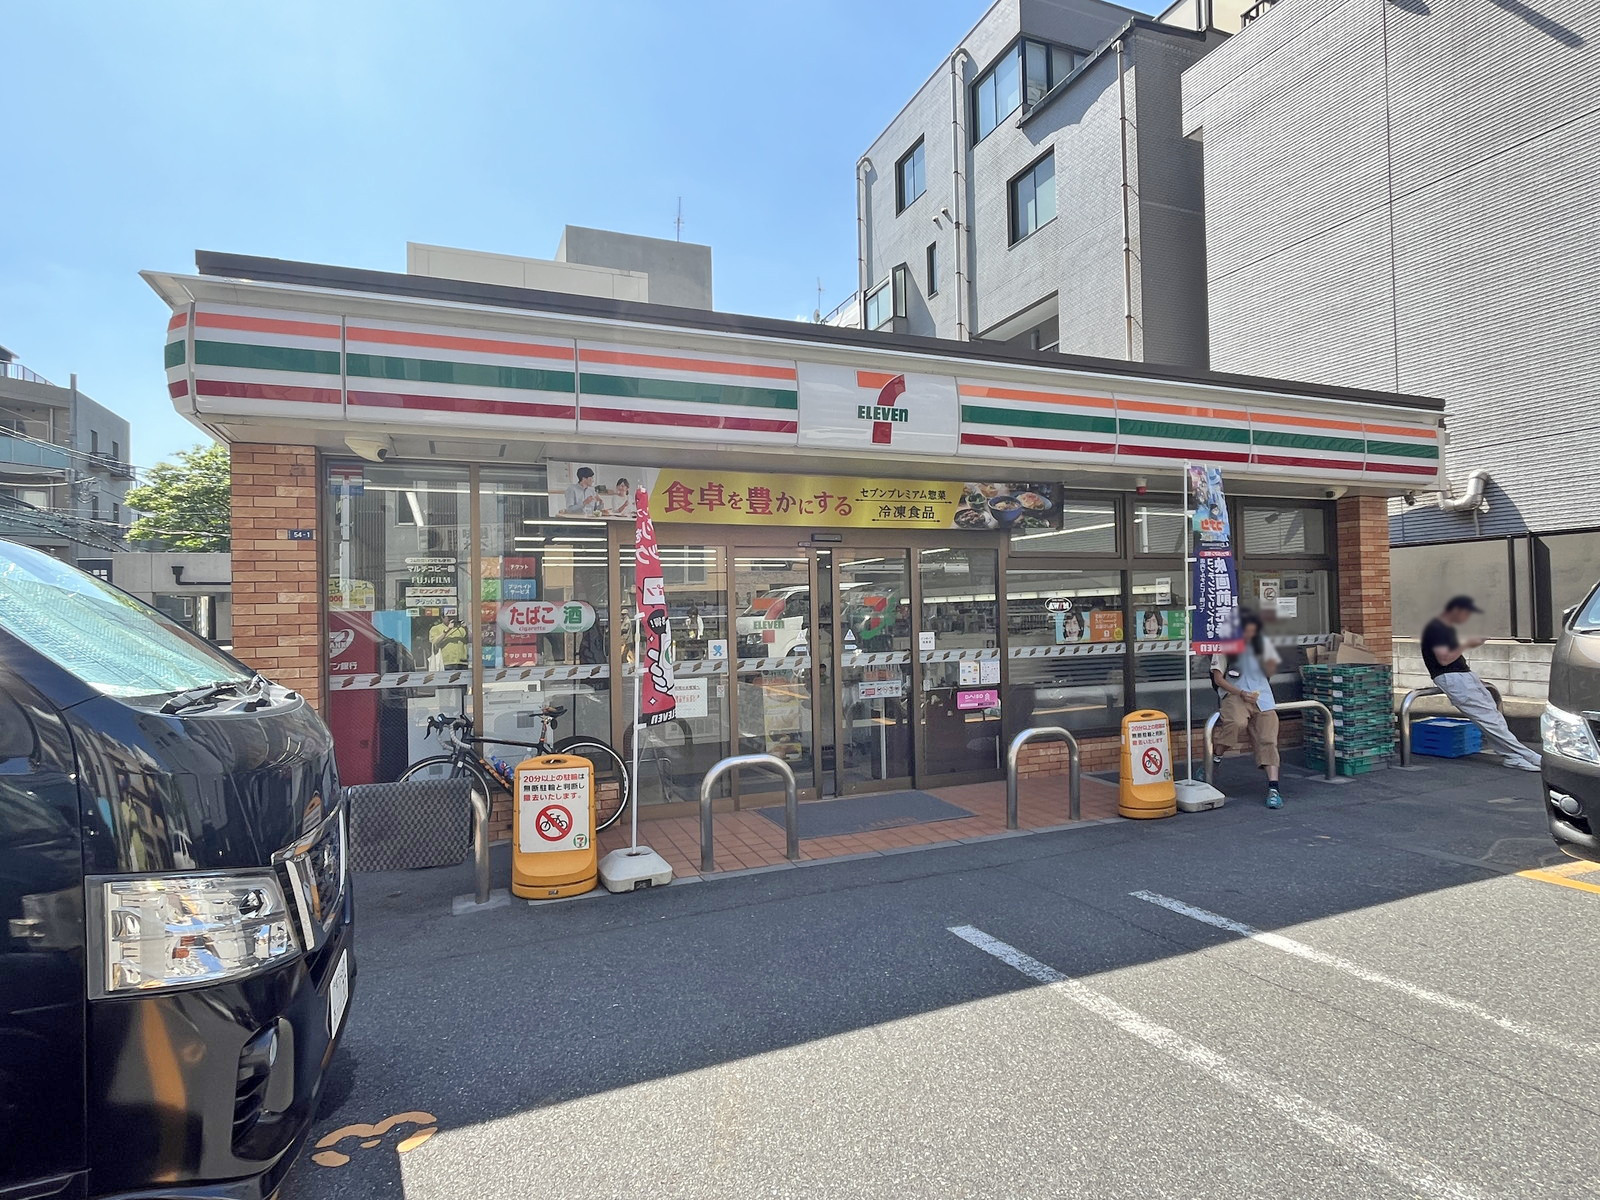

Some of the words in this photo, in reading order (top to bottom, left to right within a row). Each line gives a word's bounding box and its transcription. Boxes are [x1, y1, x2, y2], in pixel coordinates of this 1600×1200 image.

[661, 479, 853, 517] 食卓を豊かにする
[860, 486, 947, 501] セブンプレミアム惣菜
[877, 505, 936, 520] 冷凍食品
[411, 576, 451, 584] FUJIFILM
[509, 605, 555, 626] たばこ
[563, 605, 583, 625] 酒
[523, 773, 585, 783] 20分以上の駐輪は
[523, 783, 585, 792] 無断駐輪と判断し
